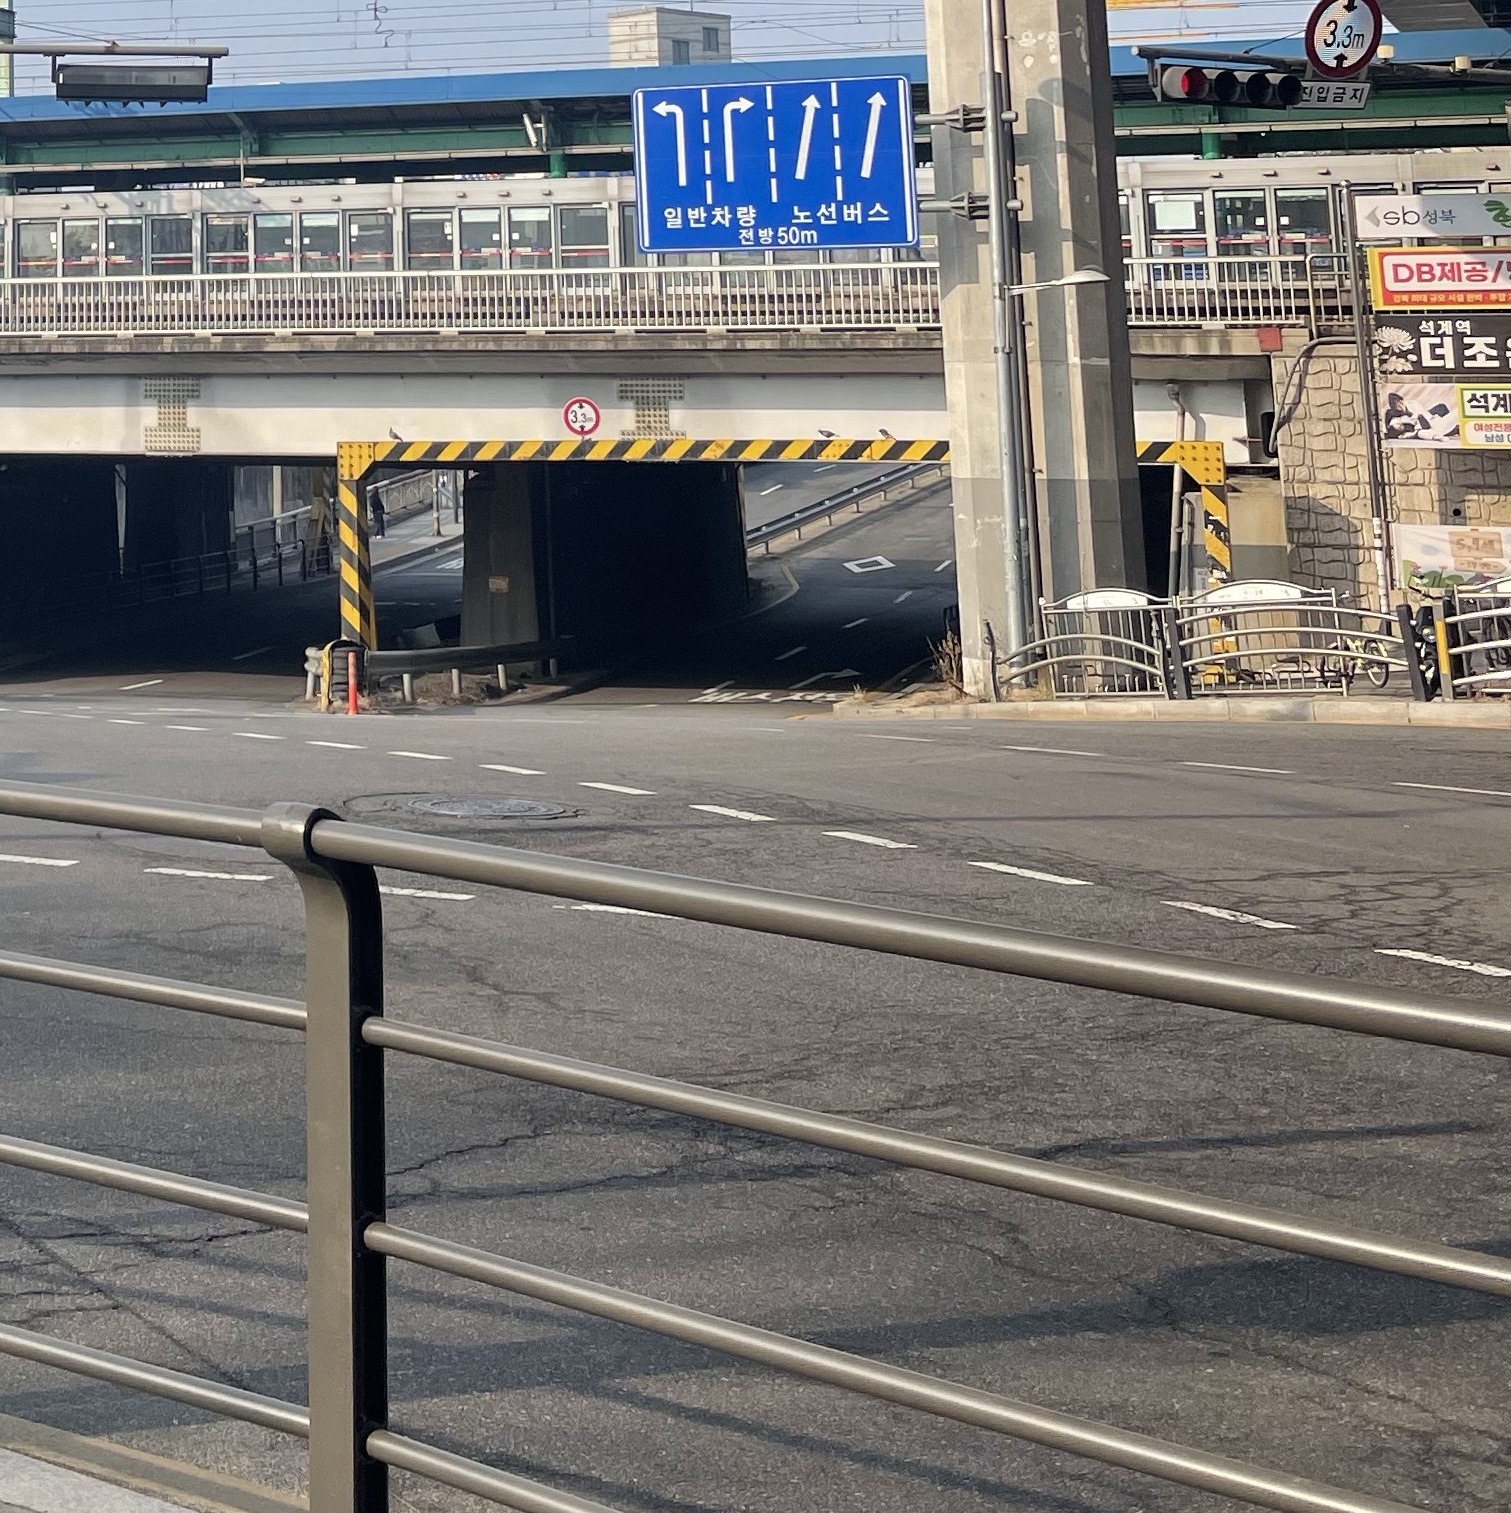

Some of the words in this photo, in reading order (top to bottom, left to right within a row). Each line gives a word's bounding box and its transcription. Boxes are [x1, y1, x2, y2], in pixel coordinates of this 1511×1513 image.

[1302, 86, 1365, 104] 진입금지
[663, 205, 757, 229] 일반차량
[791, 202, 890, 225] 노선버스
[1392, 260, 1511, 284] DB제공/
[1418, 320, 1471, 336] 석계역
[1419, 336, 1511, 370] 더조
